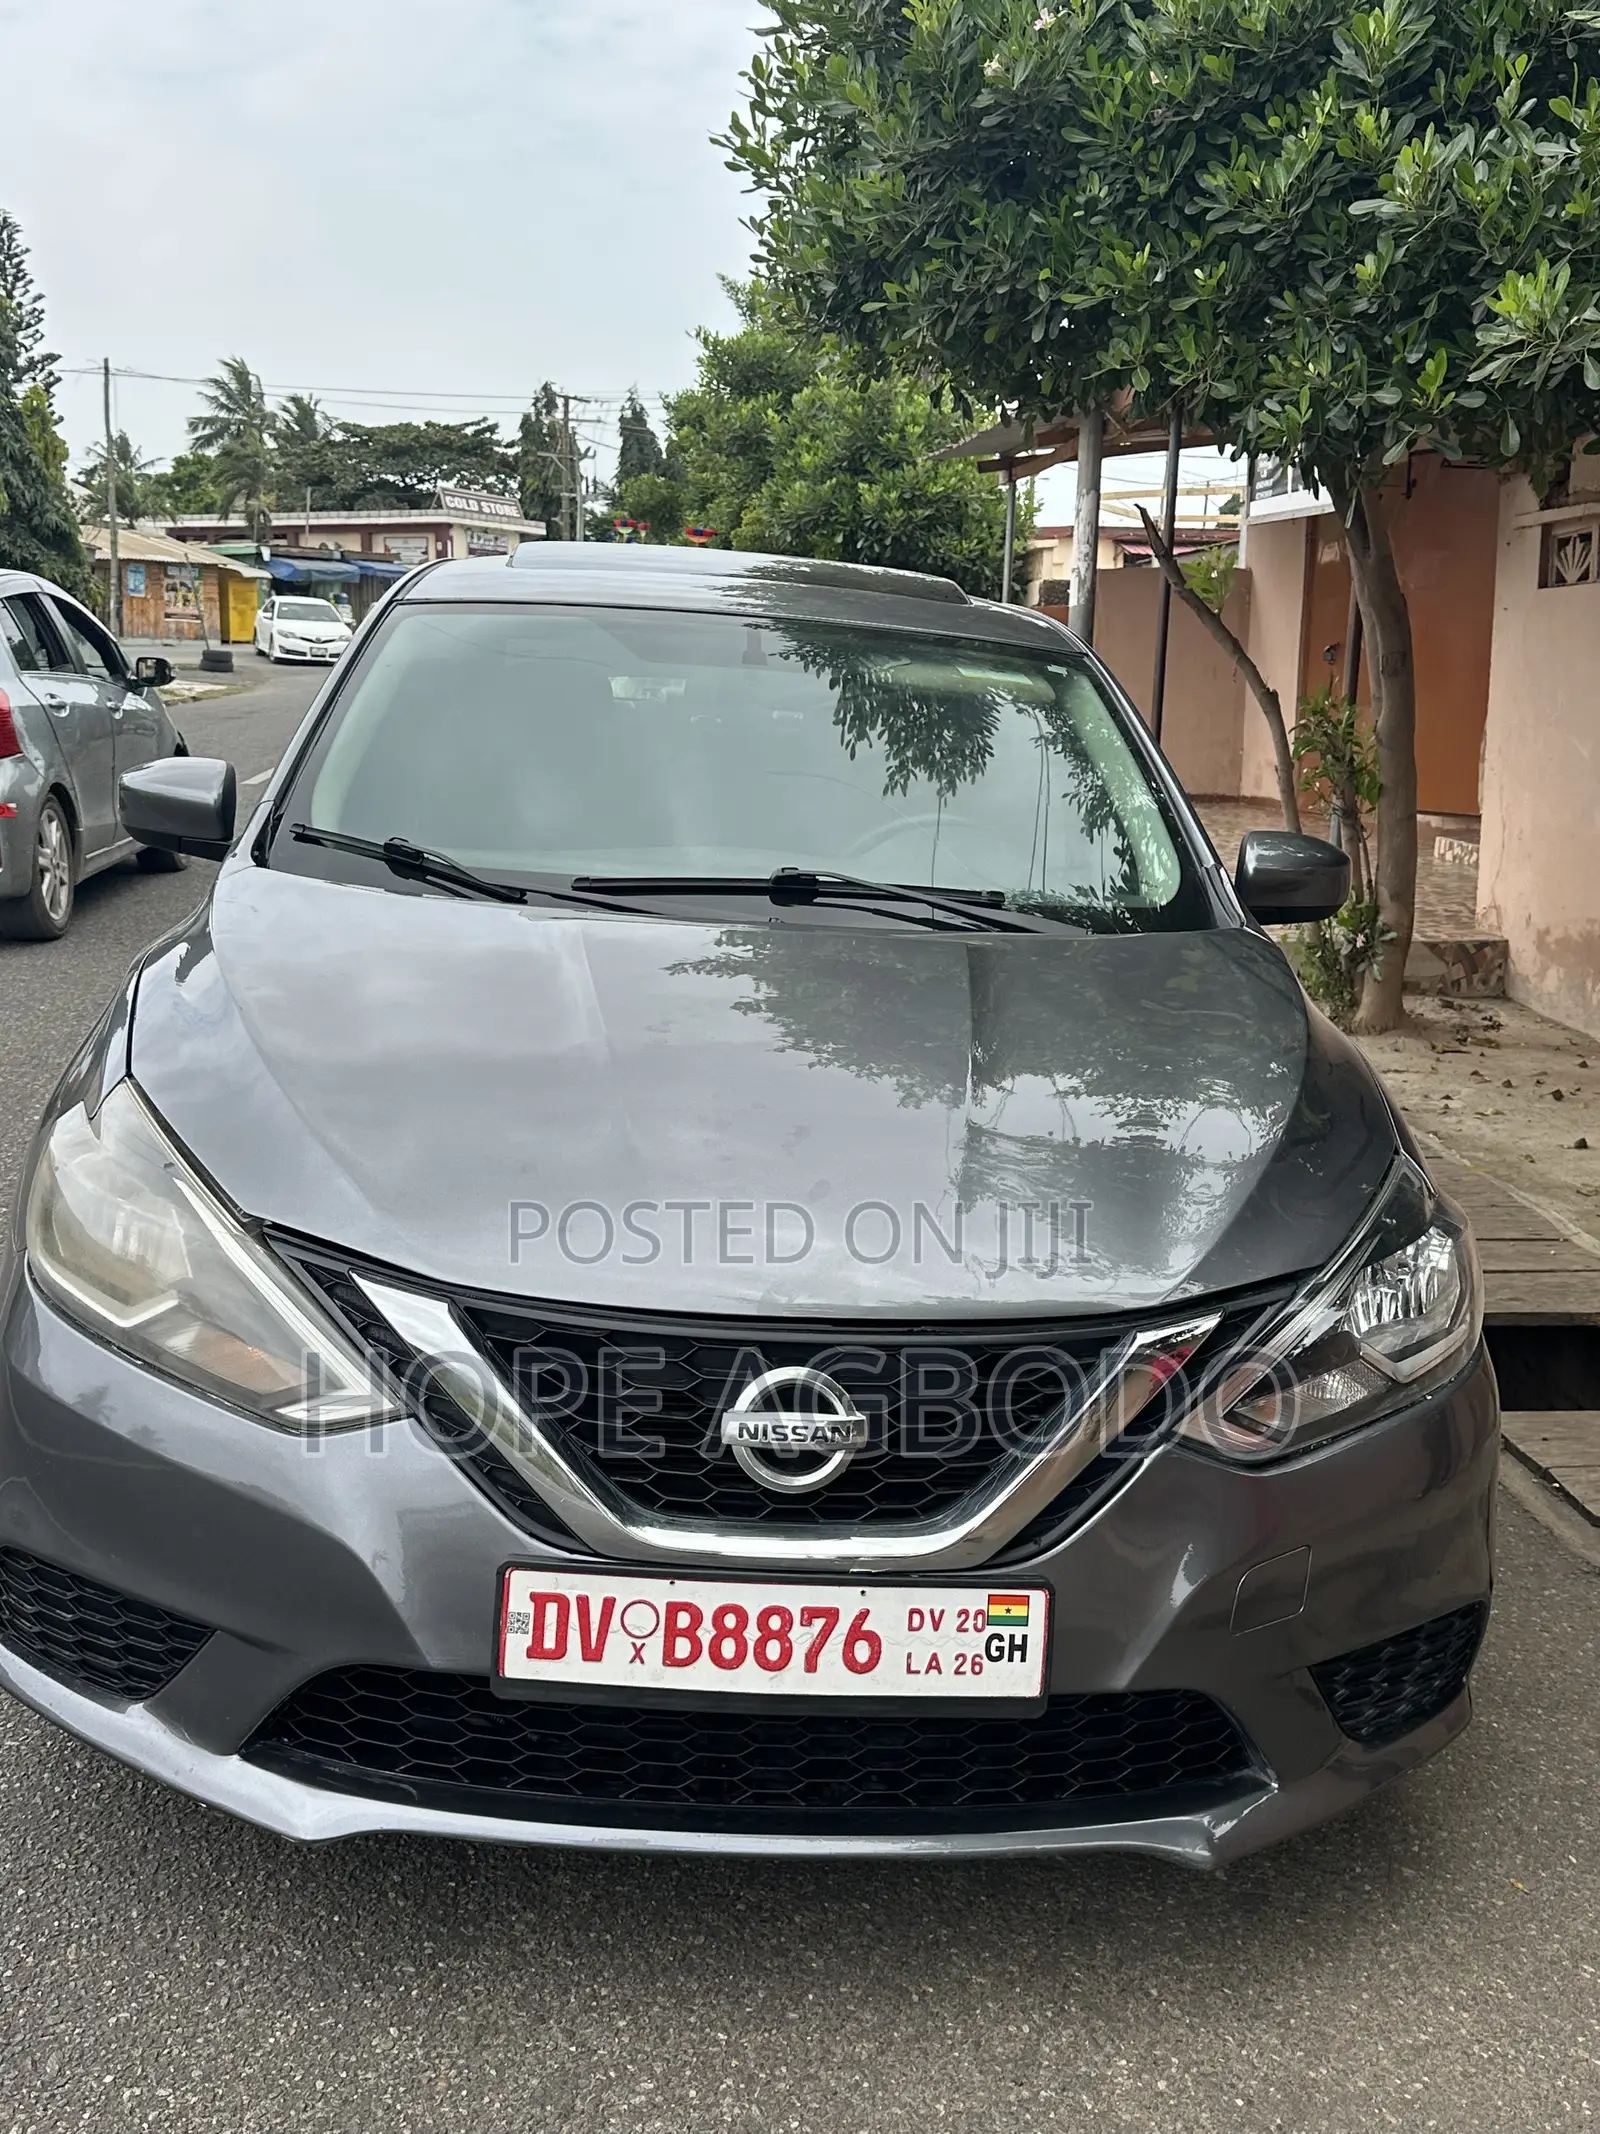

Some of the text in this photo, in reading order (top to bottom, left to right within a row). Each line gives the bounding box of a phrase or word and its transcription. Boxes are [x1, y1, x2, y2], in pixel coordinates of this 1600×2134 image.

[444, 495, 520, 517] COLD STORE
[737, 1422, 852, 1444] NISSAN
[907, 1608, 987, 1633] DV 20
[526, 1591, 882, 1675] DV B8876
[985, 1633, 1028, 1663] GH
[906, 1652, 985, 1675] LA 26
